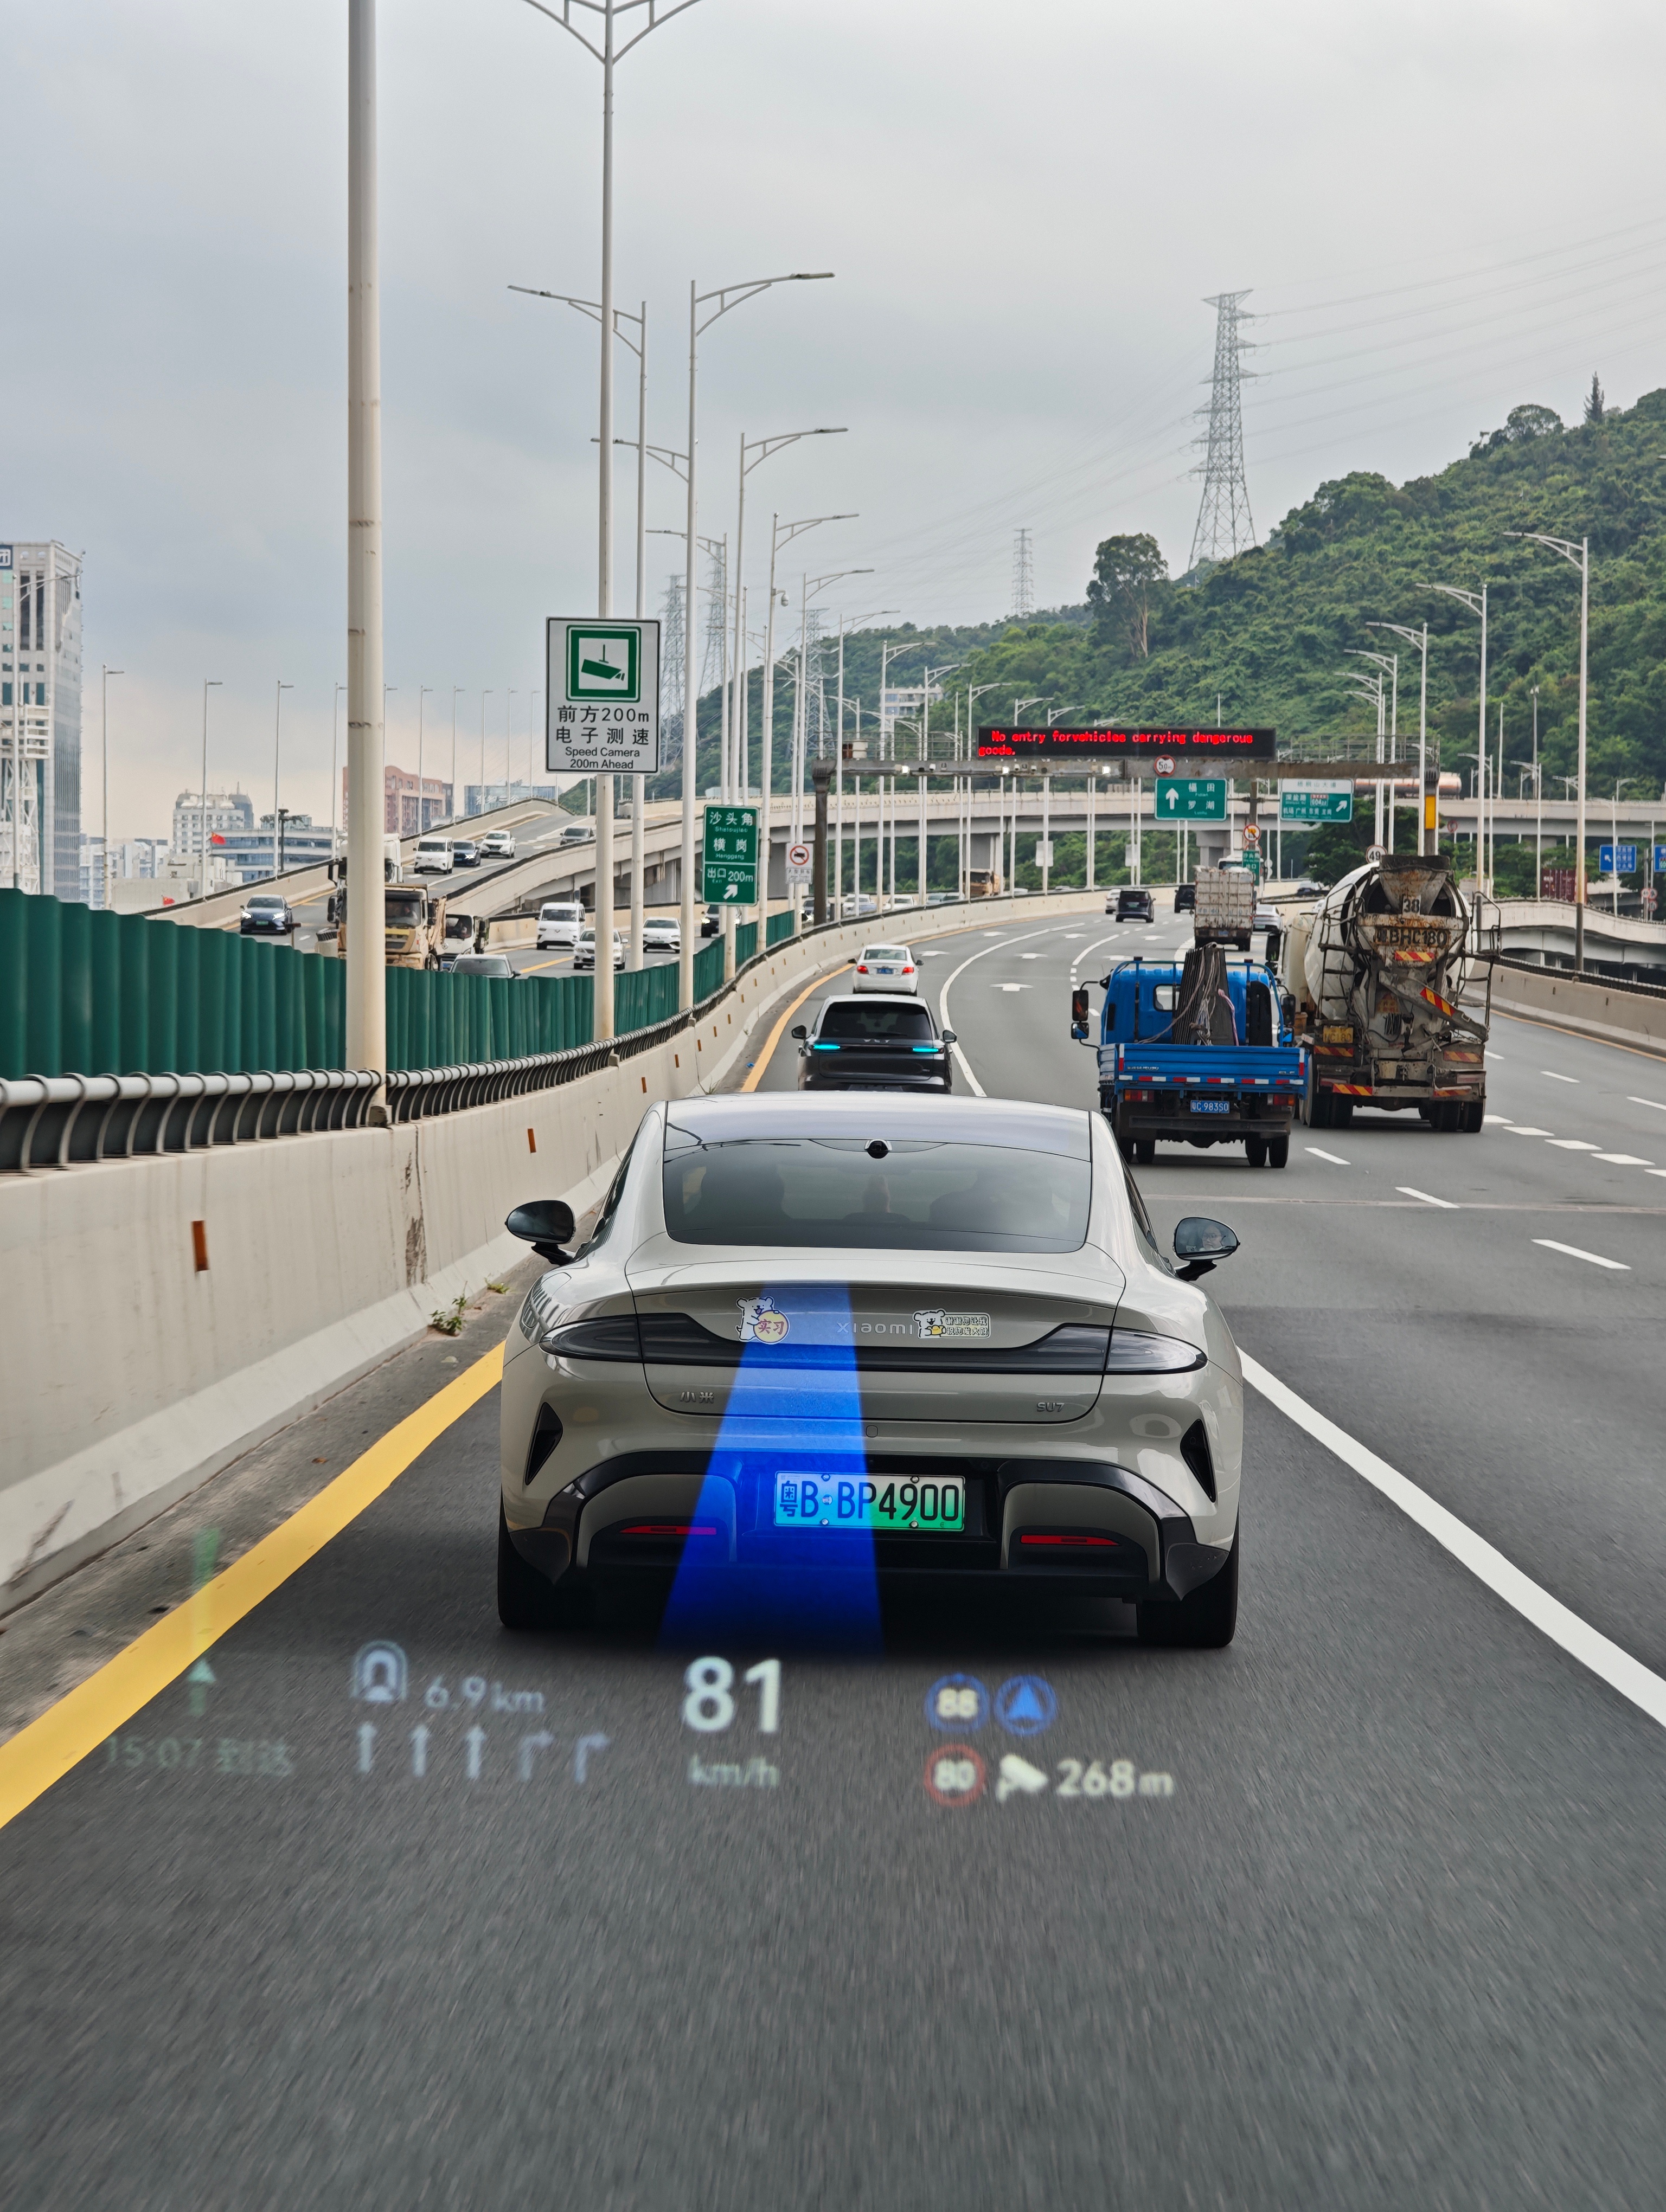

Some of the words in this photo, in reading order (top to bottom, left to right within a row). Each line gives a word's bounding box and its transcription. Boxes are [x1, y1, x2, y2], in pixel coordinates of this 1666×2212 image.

[557, 705, 649, 723] 前方200m
[556, 726, 649, 745] 电子测速
[991, 730, 1006, 742] No
[1011, 731, 1046, 744] entry
[1132, 731, 1187, 744] carrying
[1193, 731, 1253, 744] dangerous
[565, 747, 598, 758] Speed
[600, 748, 640, 757] Camera
[570, 759, 599, 769] 200m
[601, 760, 633, 769] Ahead
[709, 811, 753, 826] 沙头角
[713, 837, 747, 853] 横岗
[707, 867, 727, 879] 出口
[728, 871, 753, 883] 200m
[758, 1319, 785, 1335] 实习
[680, 1391, 714, 1404] 小米
[1036, 1401, 1065, 1412] SU7
[682, 1655, 782, 1734] 81
[688, 1754, 780, 1787] km/h
